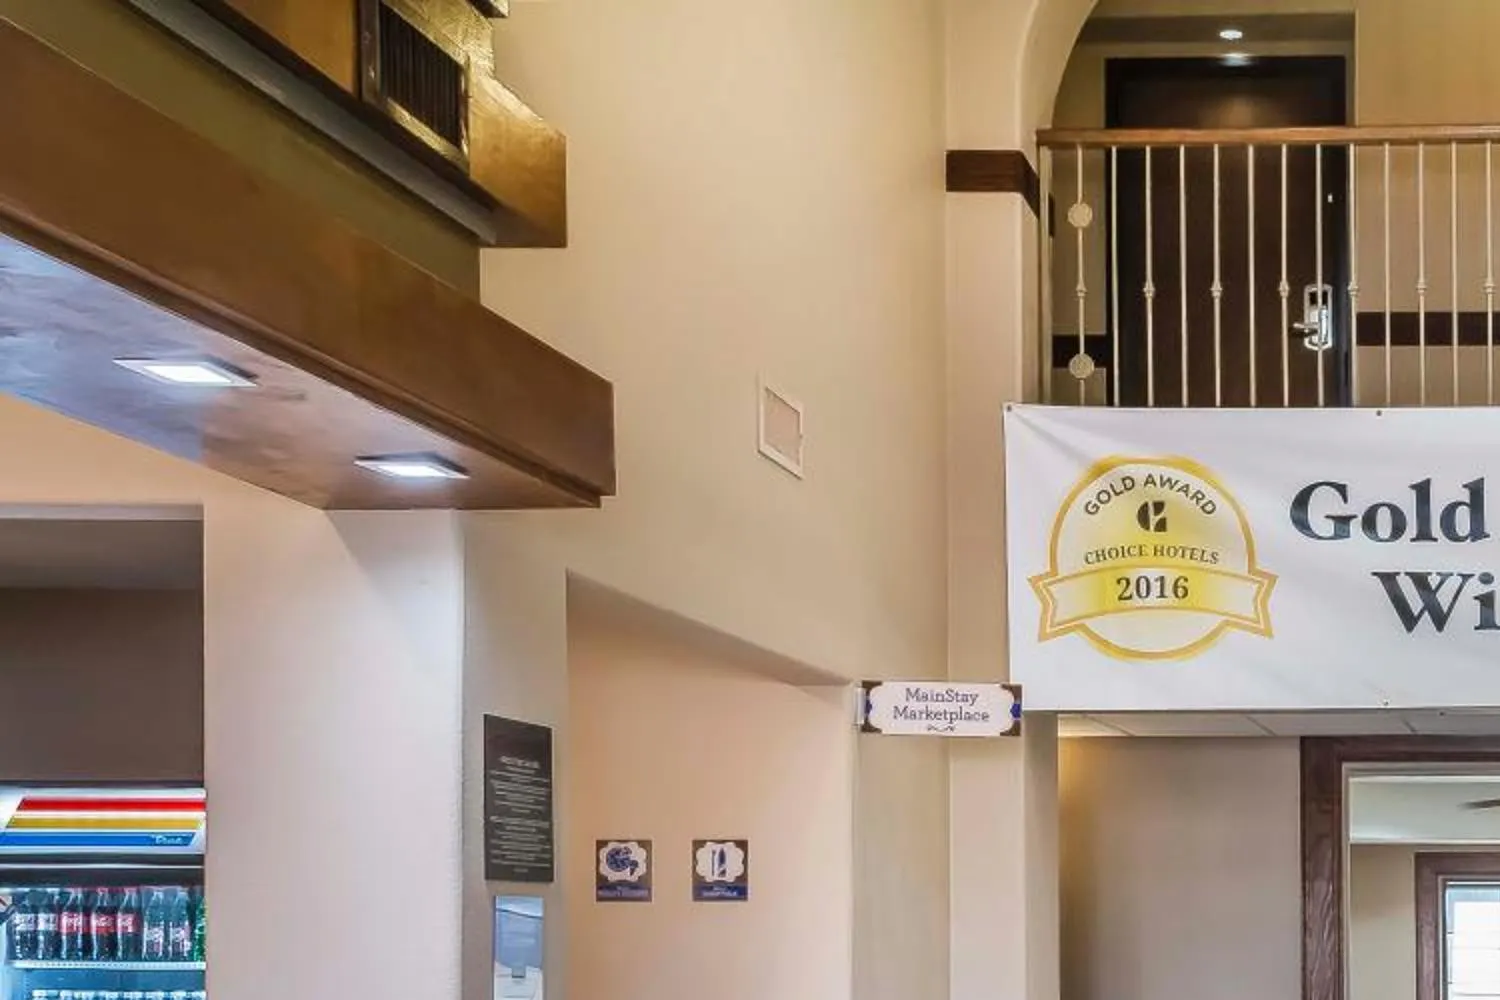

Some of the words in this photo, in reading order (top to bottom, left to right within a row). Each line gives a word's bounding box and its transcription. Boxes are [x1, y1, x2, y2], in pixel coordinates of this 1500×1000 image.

[1084, 476, 1135, 515] GOLD
[1144, 473, 1217, 515] AWARD
[1289, 477, 1491, 543] Gold
[1085, 544, 1149, 564] CHOICE
[1153, 545, 1220, 564] HOTELS
[1116, 575, 1189, 601] 2016
[905, 687, 979, 706] MainStay
[893, 706, 990, 724] Marketplace
